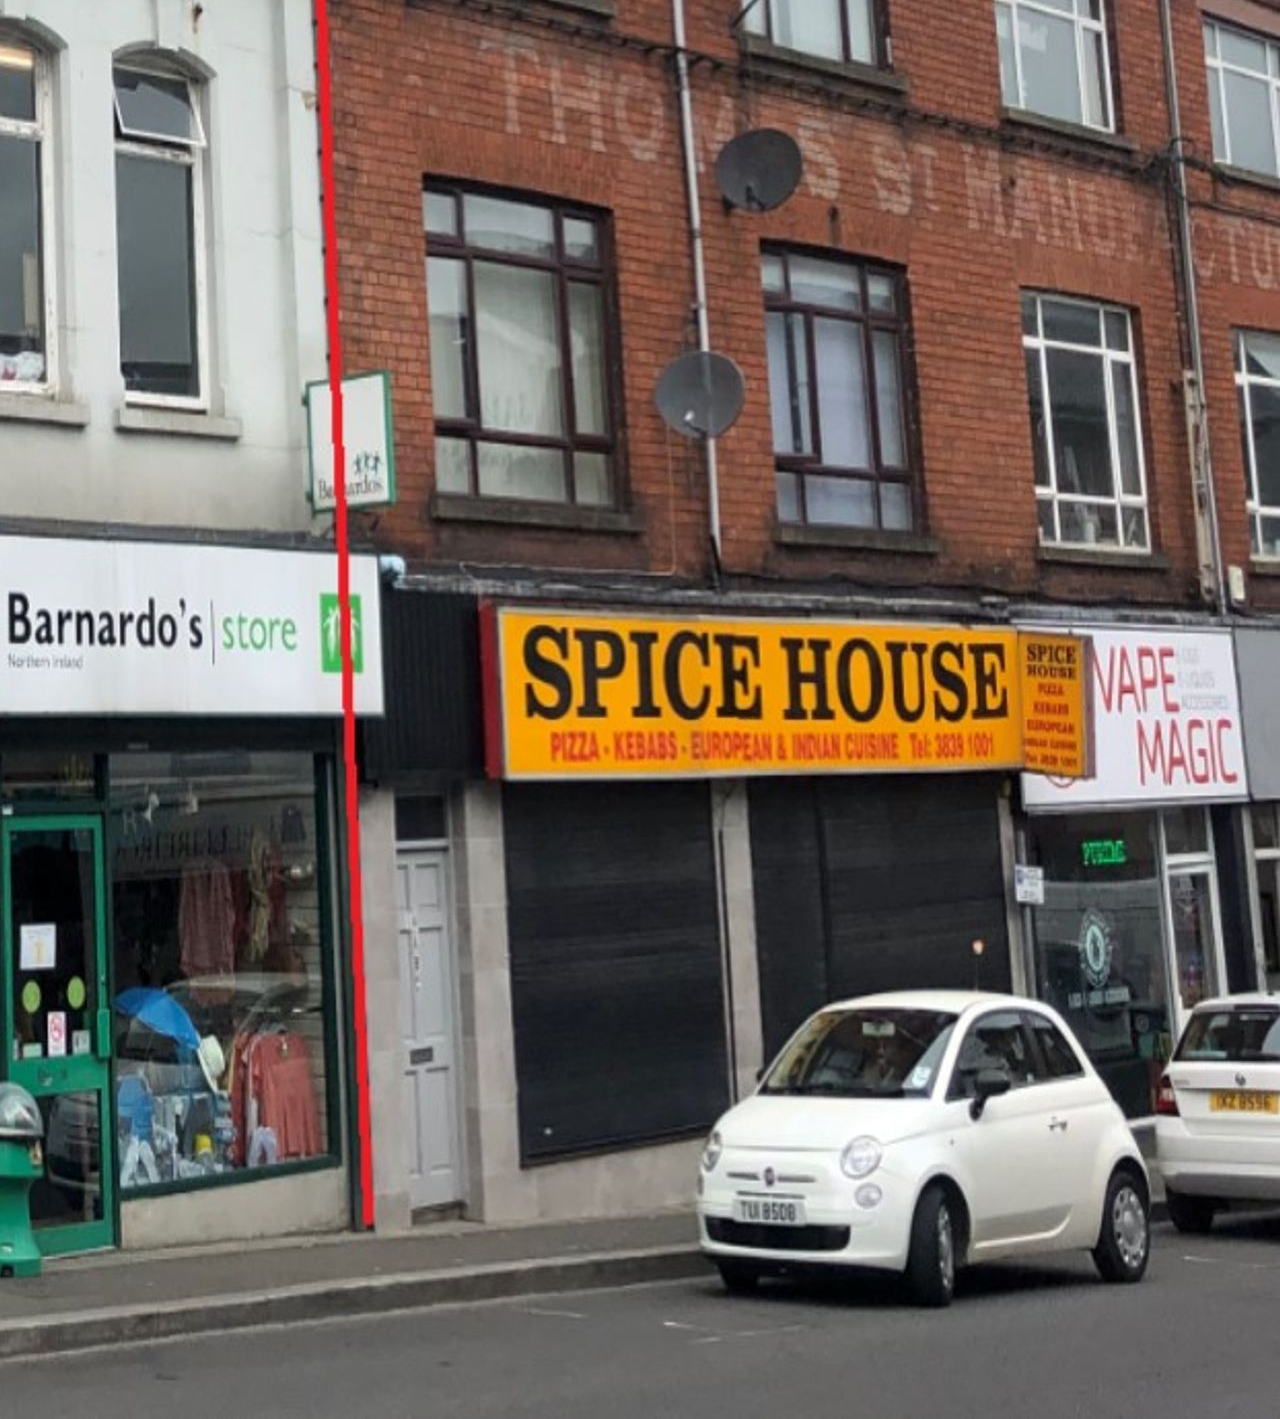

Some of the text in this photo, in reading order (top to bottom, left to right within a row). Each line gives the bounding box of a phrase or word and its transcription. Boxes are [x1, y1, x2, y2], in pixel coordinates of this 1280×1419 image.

[8, 592, 298, 651] Barnardo's store
[8, 654, 50, 668] Northern
[523, 625, 1008, 723] SPICE HOUSE
[1026, 643, 1076, 665] SPICE
[1027, 664, 1076, 680] HOUSE
[1092, 645, 1180, 713] VAPE
[550, 731, 600, 762] PIZZA
[613, 732, 678, 761] KEBABS
[691, 732, 772, 762] EUROPEAN
[776, 734, 787, 760] &
[792, 733, 840, 760] INDIAN
[845, 733, 899, 760] CUISINE
[967, 731, 994, 758] 1001
[1136, 719, 1238, 786] MAGIC
